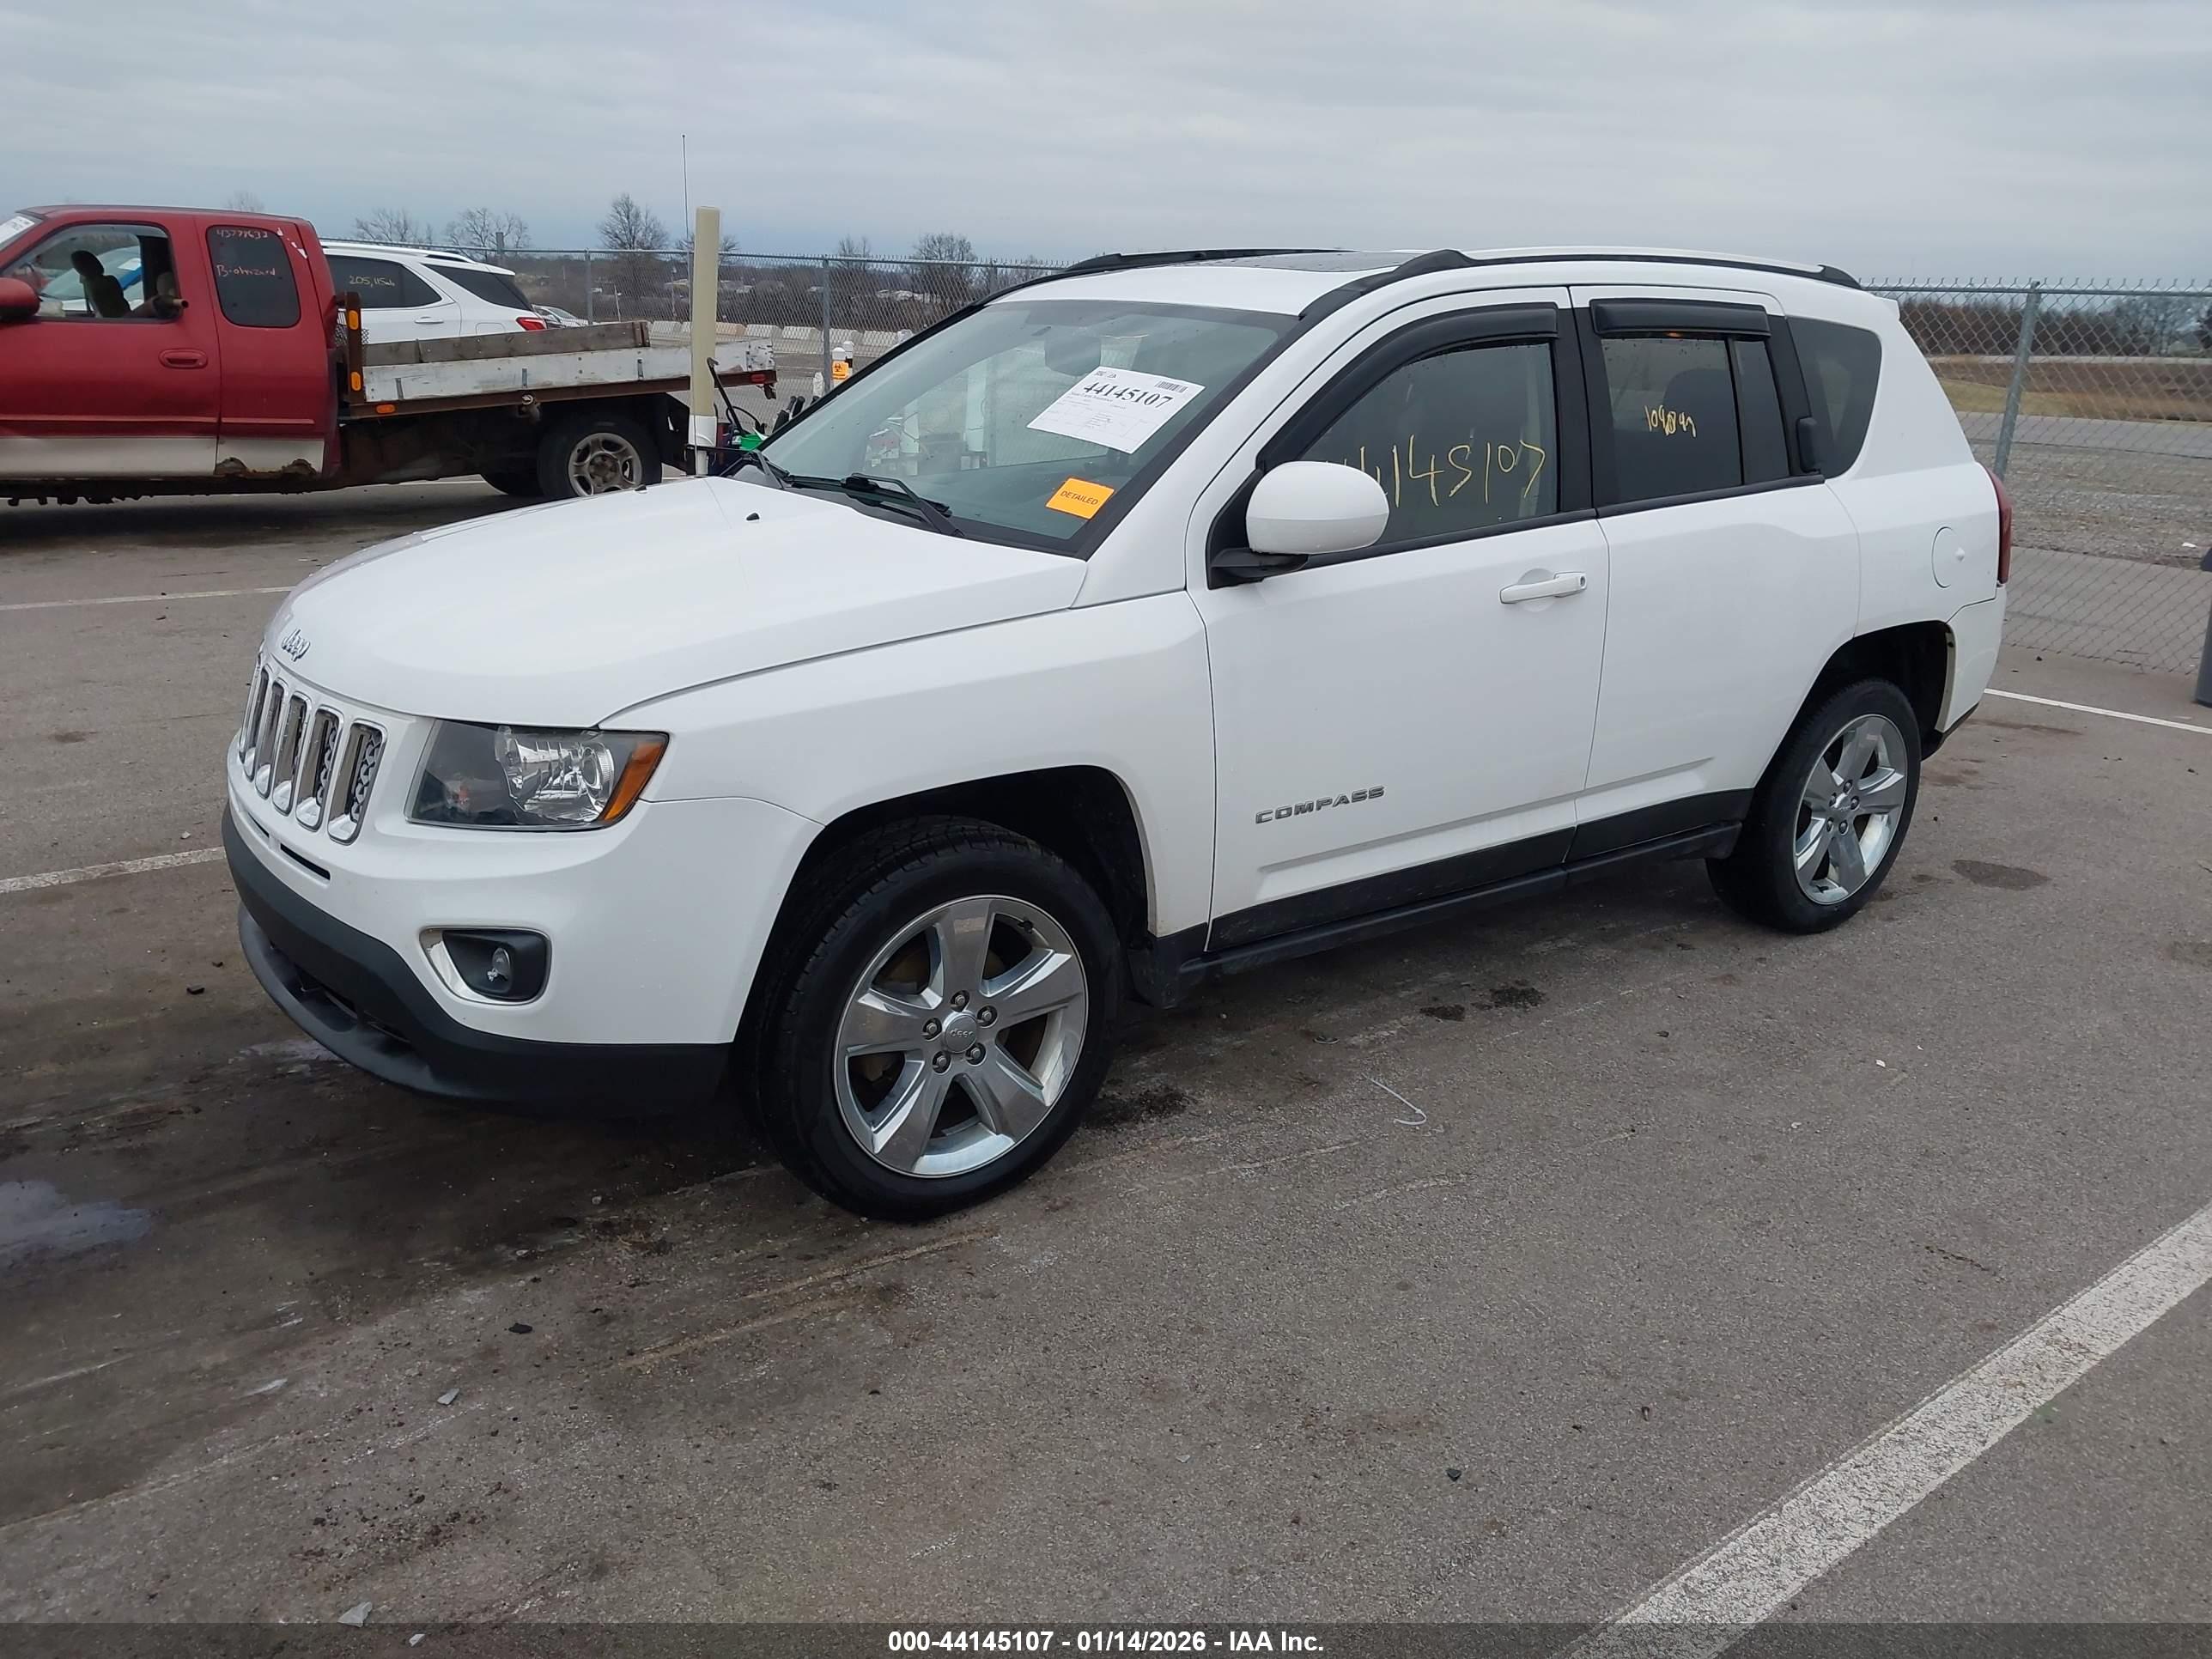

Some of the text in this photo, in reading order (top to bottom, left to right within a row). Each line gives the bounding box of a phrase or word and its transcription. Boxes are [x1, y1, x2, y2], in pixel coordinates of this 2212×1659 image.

[1083, 381, 1175, 409] 44145107
[1060, 490, 1099, 506] DETAILED
[281, 629, 311, 662] Jeep
[1255, 785, 1385, 824] COMPASS
